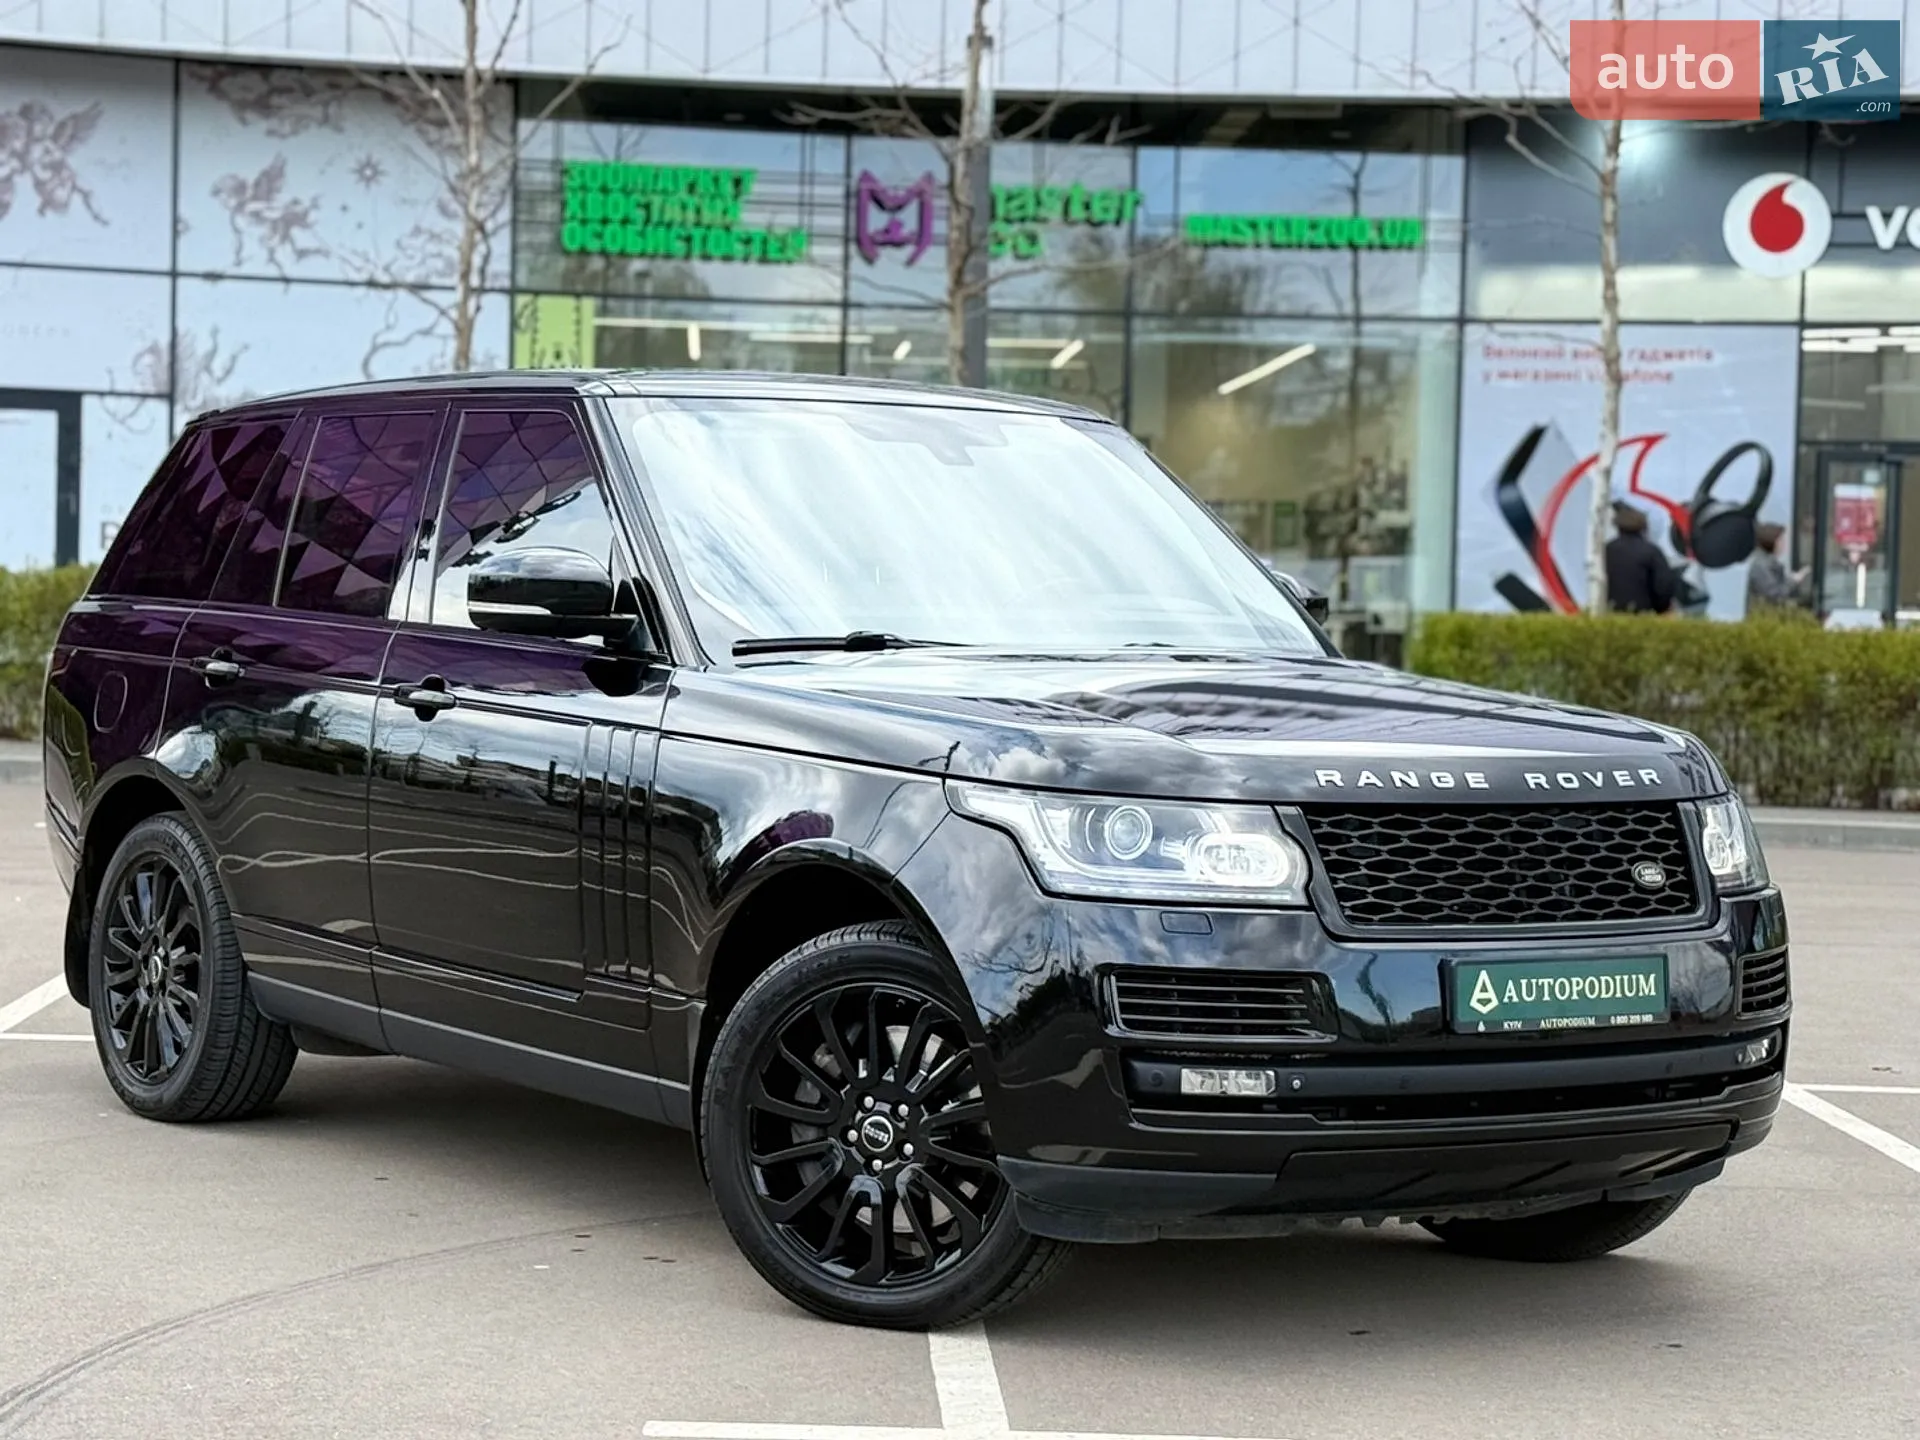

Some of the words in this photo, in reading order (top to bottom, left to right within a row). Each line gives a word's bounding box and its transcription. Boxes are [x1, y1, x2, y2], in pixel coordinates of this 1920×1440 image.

[1315, 768, 1490, 790] RANGE
[1523, 768, 1663, 790] ROVER
[1502, 974, 1657, 1004] AUTOPODIUM
[1539, 1016, 1596, 1029] AUTOPODIUM
